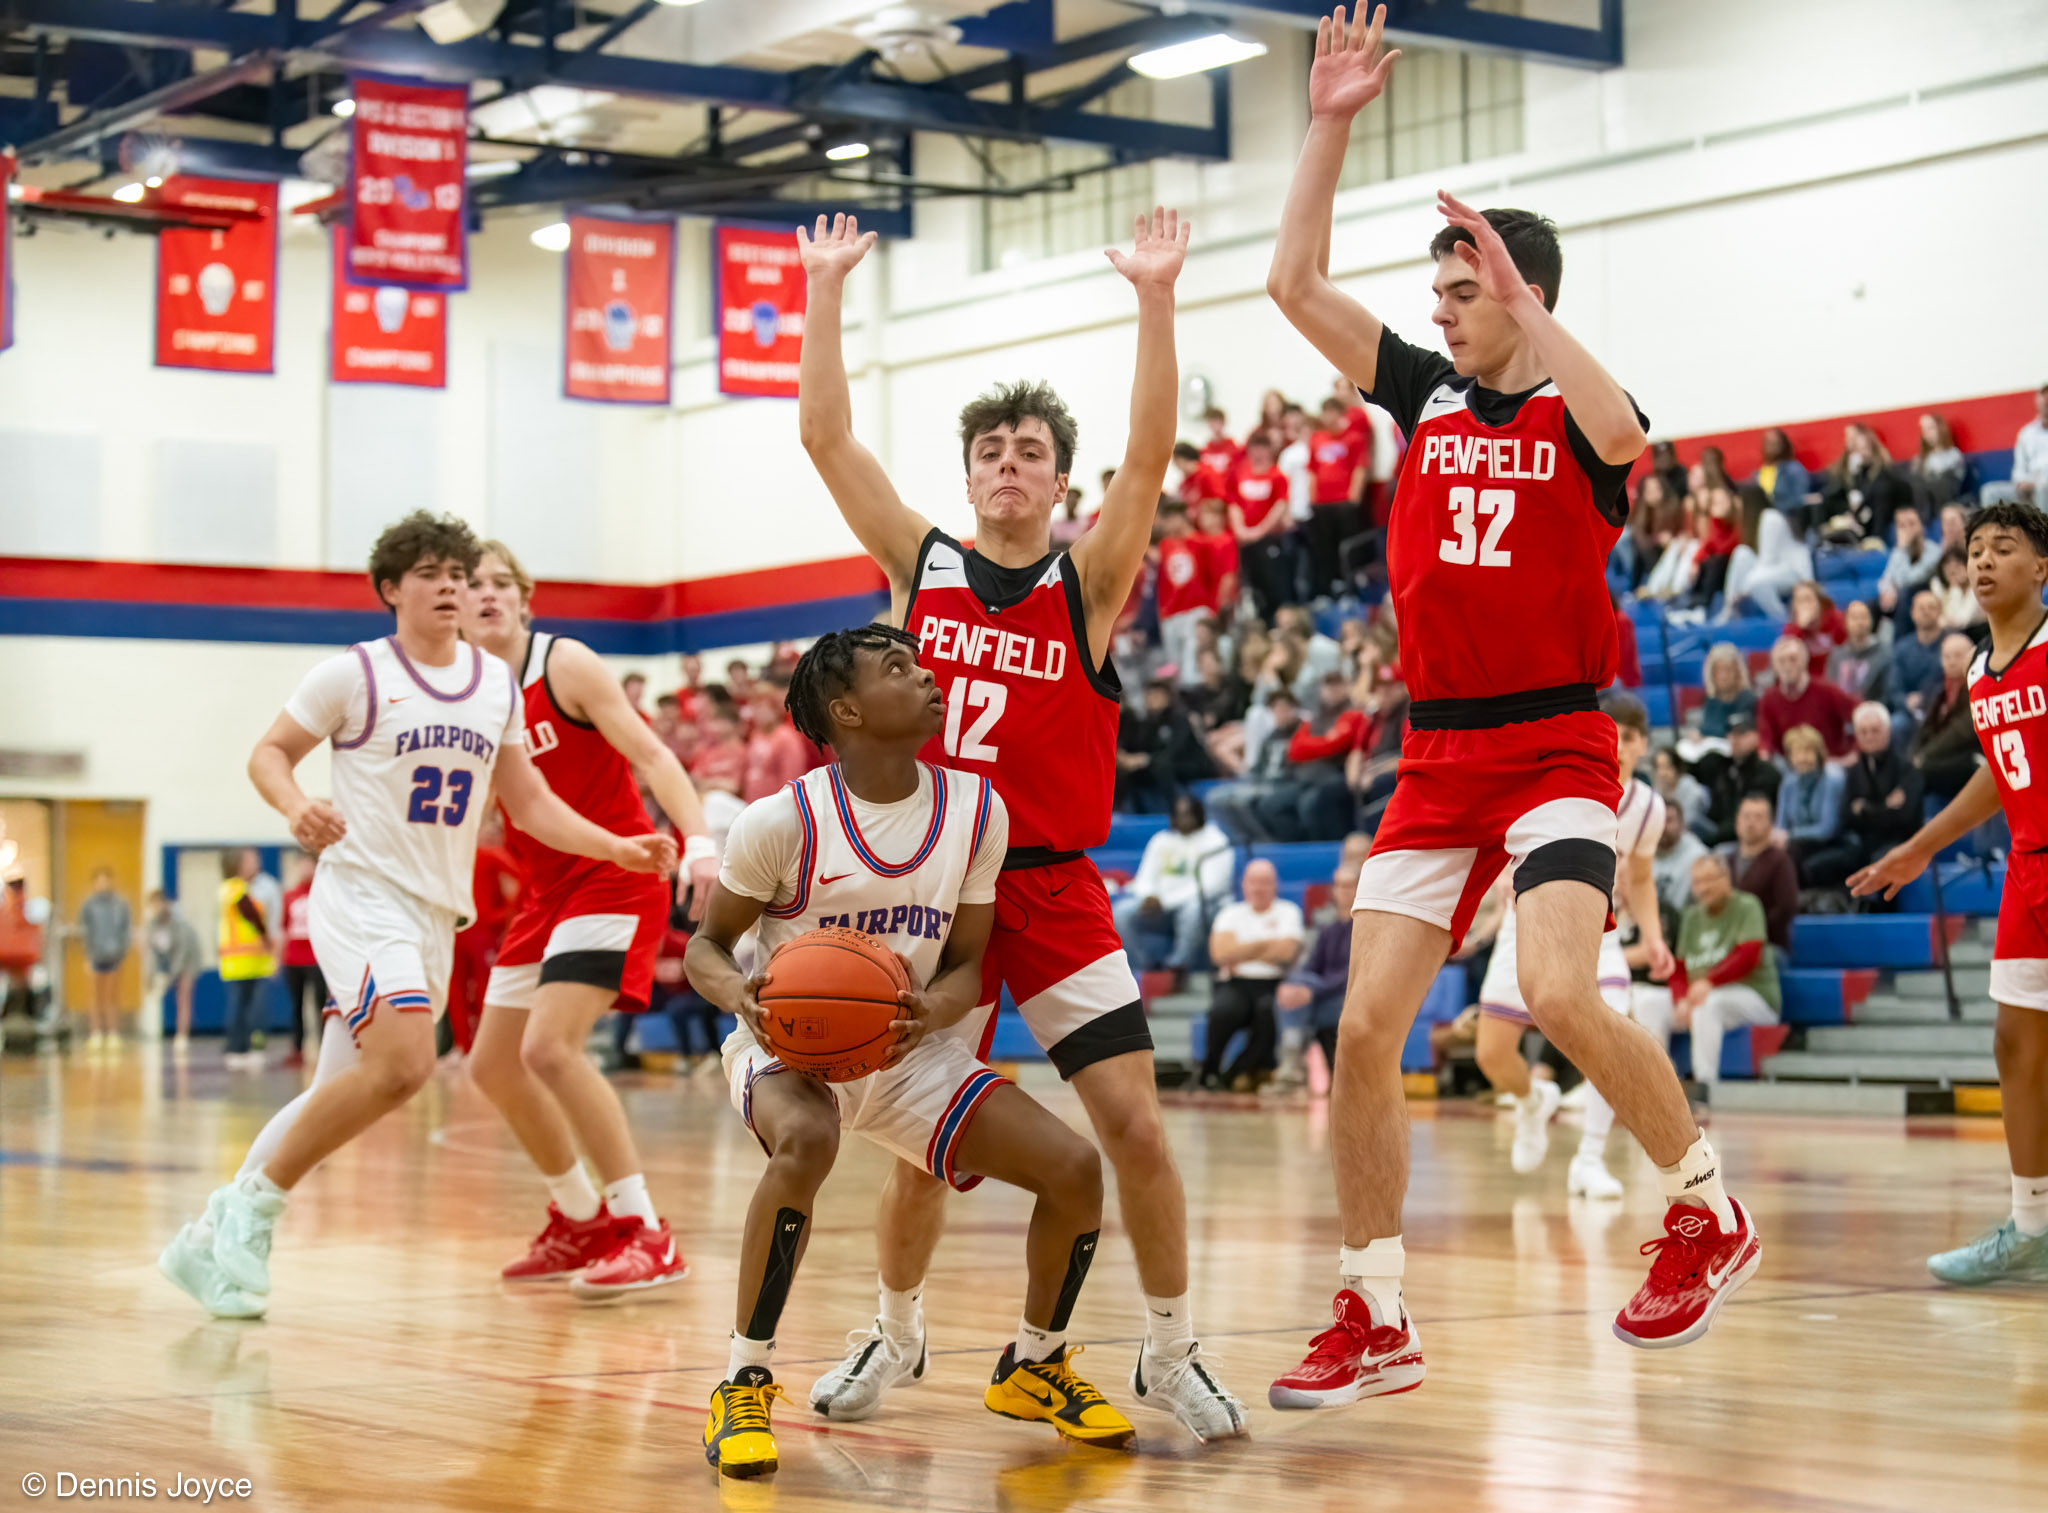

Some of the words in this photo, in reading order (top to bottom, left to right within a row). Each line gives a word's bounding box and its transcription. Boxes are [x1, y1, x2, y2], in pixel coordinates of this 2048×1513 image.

[1421, 435, 1556, 481] PENFIELD
[1439, 487, 1515, 567] 32
[919, 615, 1067, 682] PENFIELD
[395, 725, 494, 765] FAIRPORT
[944, 676, 1008, 763] 12
[1992, 729, 2031, 791] 13
[407, 765, 474, 826] 23
[1683, 1167, 1716, 1190] ZAMST
[784, 1223, 797, 1232] KT
[1083, 1242, 1094, 1252] KT
